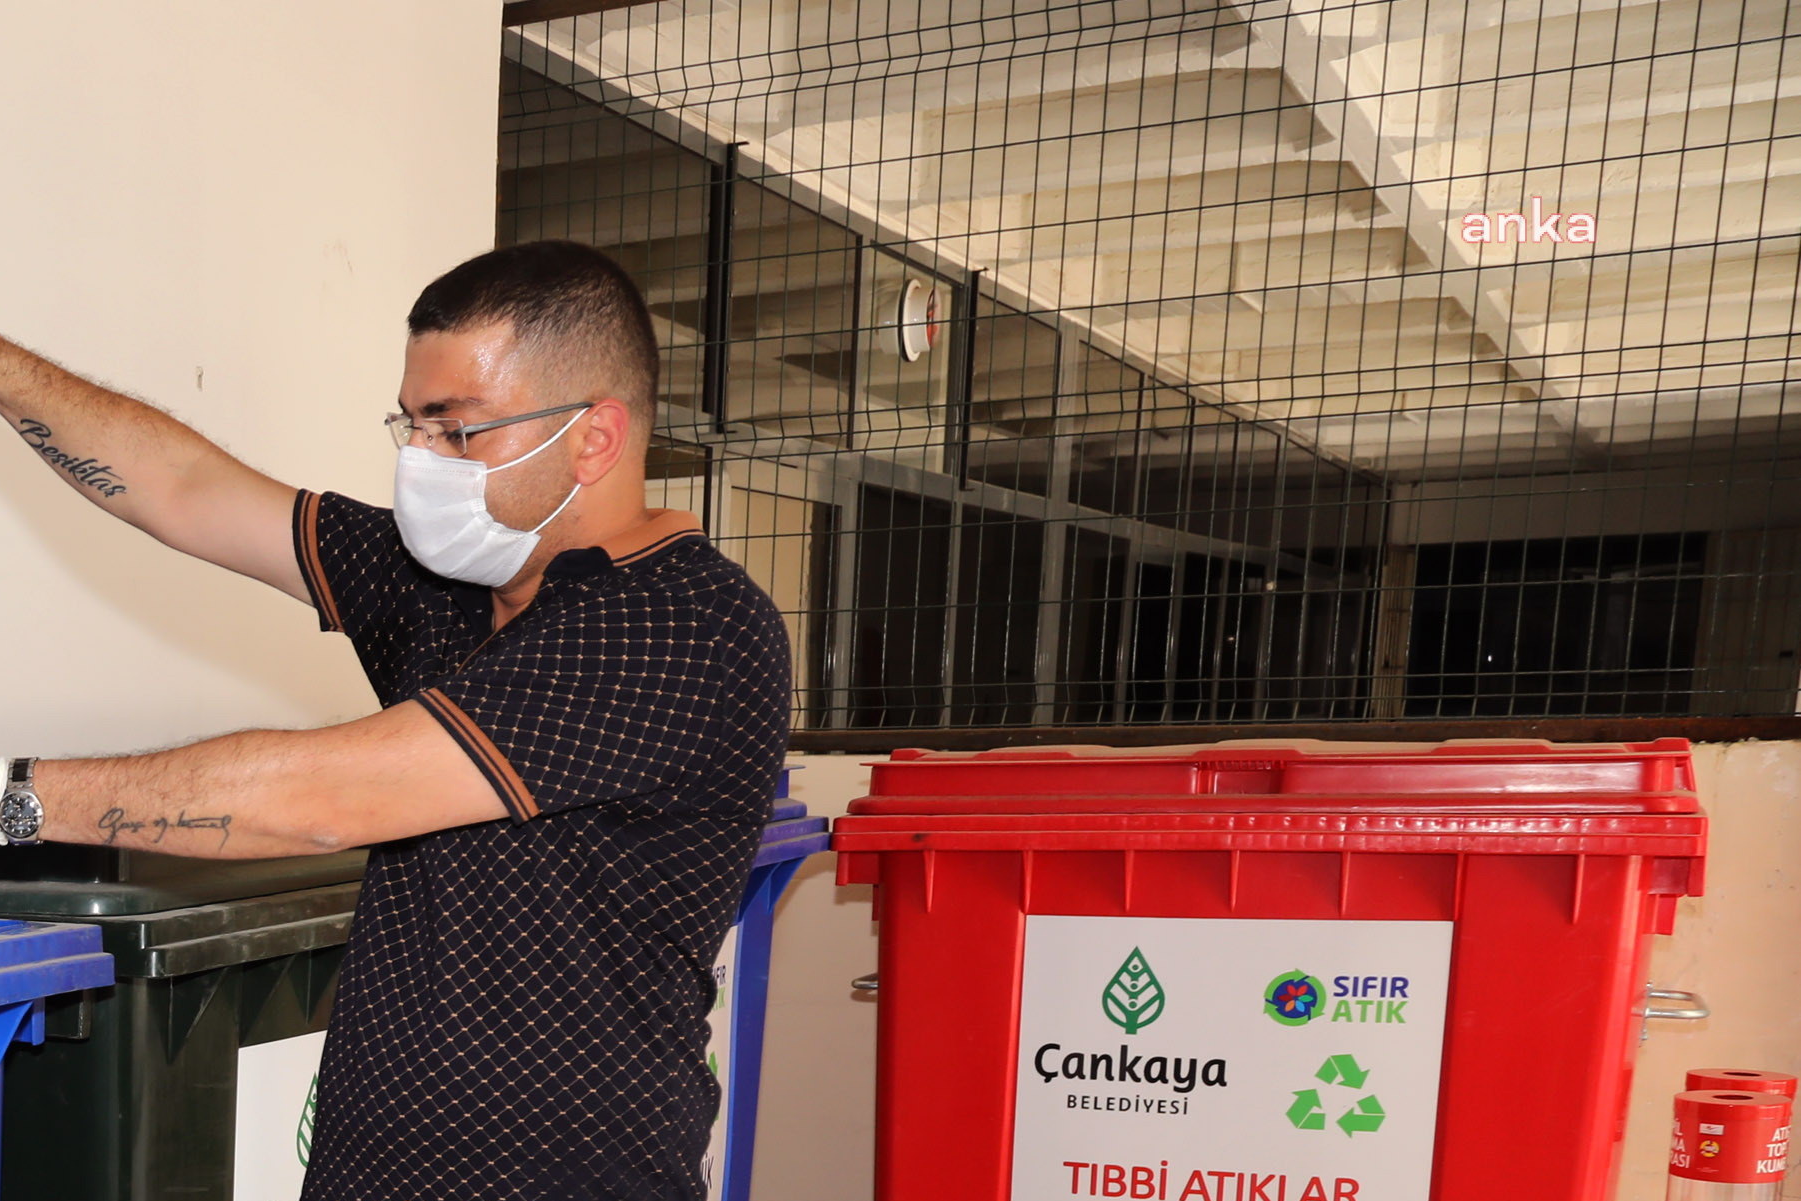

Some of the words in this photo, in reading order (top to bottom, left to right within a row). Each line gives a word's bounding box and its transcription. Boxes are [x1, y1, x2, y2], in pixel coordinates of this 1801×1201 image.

[1332, 975, 1410, 998] SIFIR
[1331, 1000, 1407, 1024] ATIK
[1034, 1043, 1227, 1093] Çankaya
[1067, 1094, 1189, 1115] BELEDİYESİ
[1063, 1160, 1168, 1200] TIBBİ
